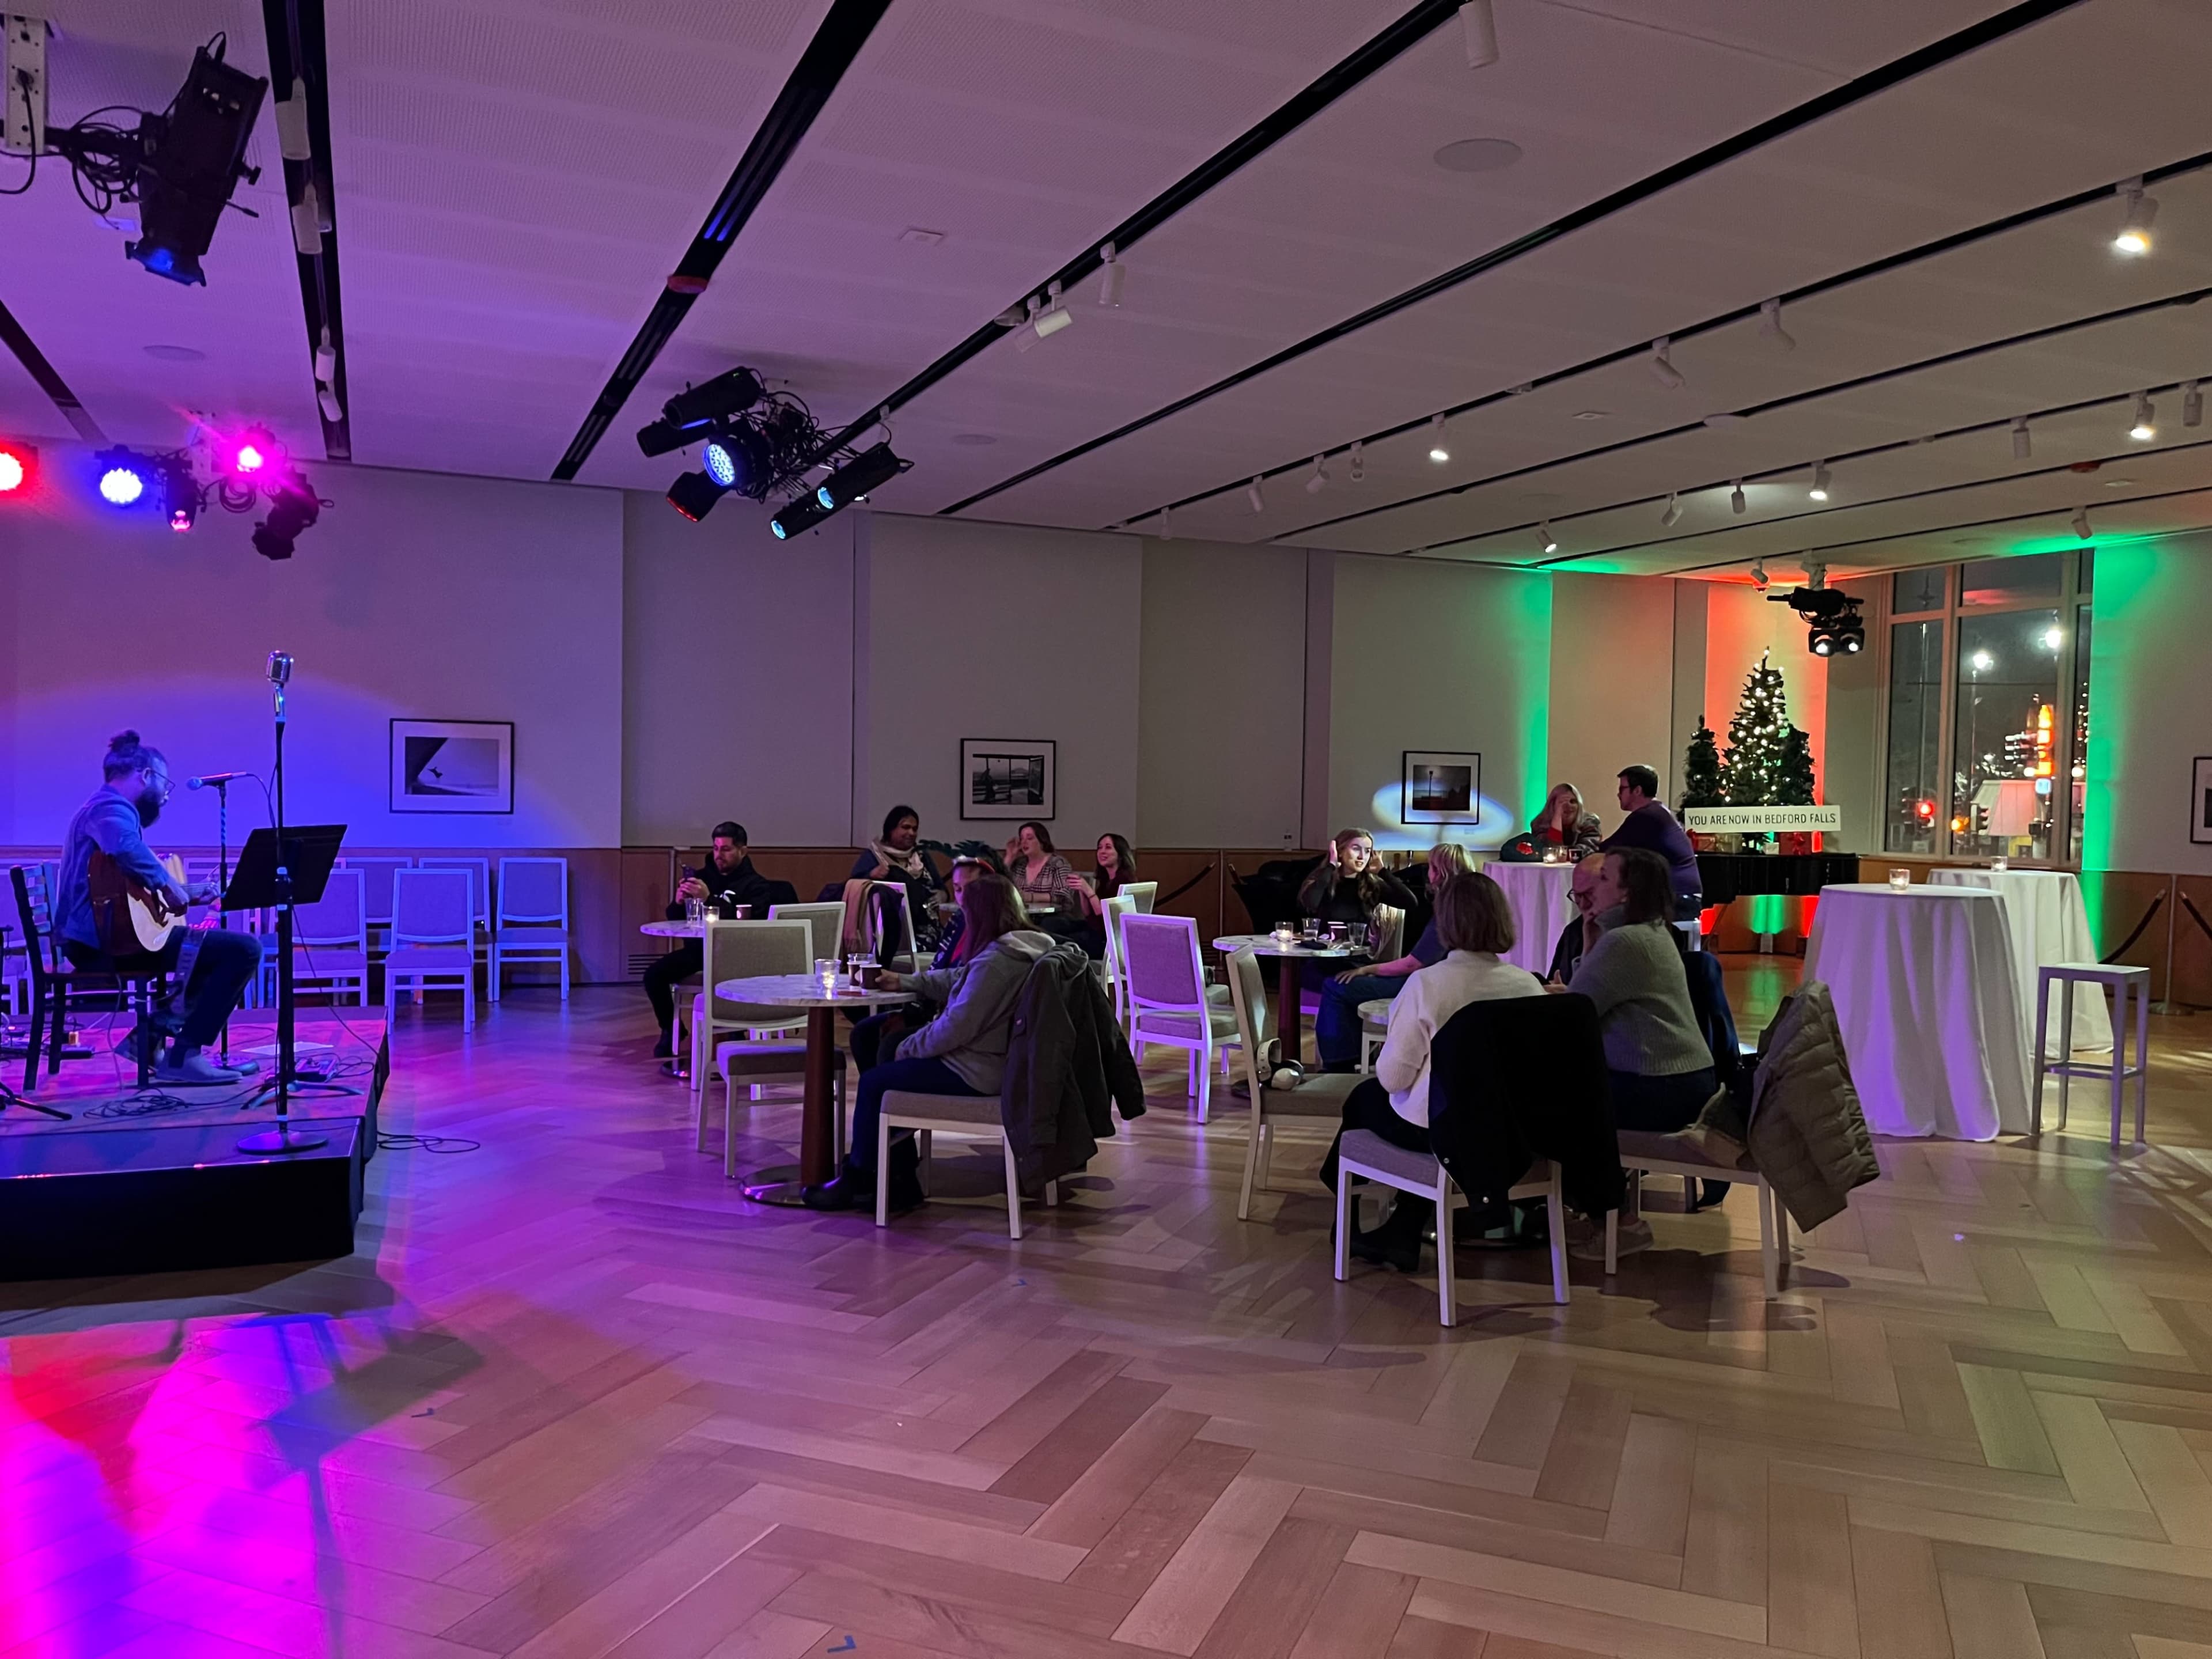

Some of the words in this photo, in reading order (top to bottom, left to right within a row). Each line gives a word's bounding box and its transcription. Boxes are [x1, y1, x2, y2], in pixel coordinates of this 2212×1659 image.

[1688, 815, 1707, 825] YOU
[1710, 815, 1726, 824] ARE
[1728, 815, 1749, 824] NOW
[1752, 814, 1762, 824] IN
[1764, 813, 1806, 824] BEDFORD
[1810, 813, 1836, 823] FALLS
